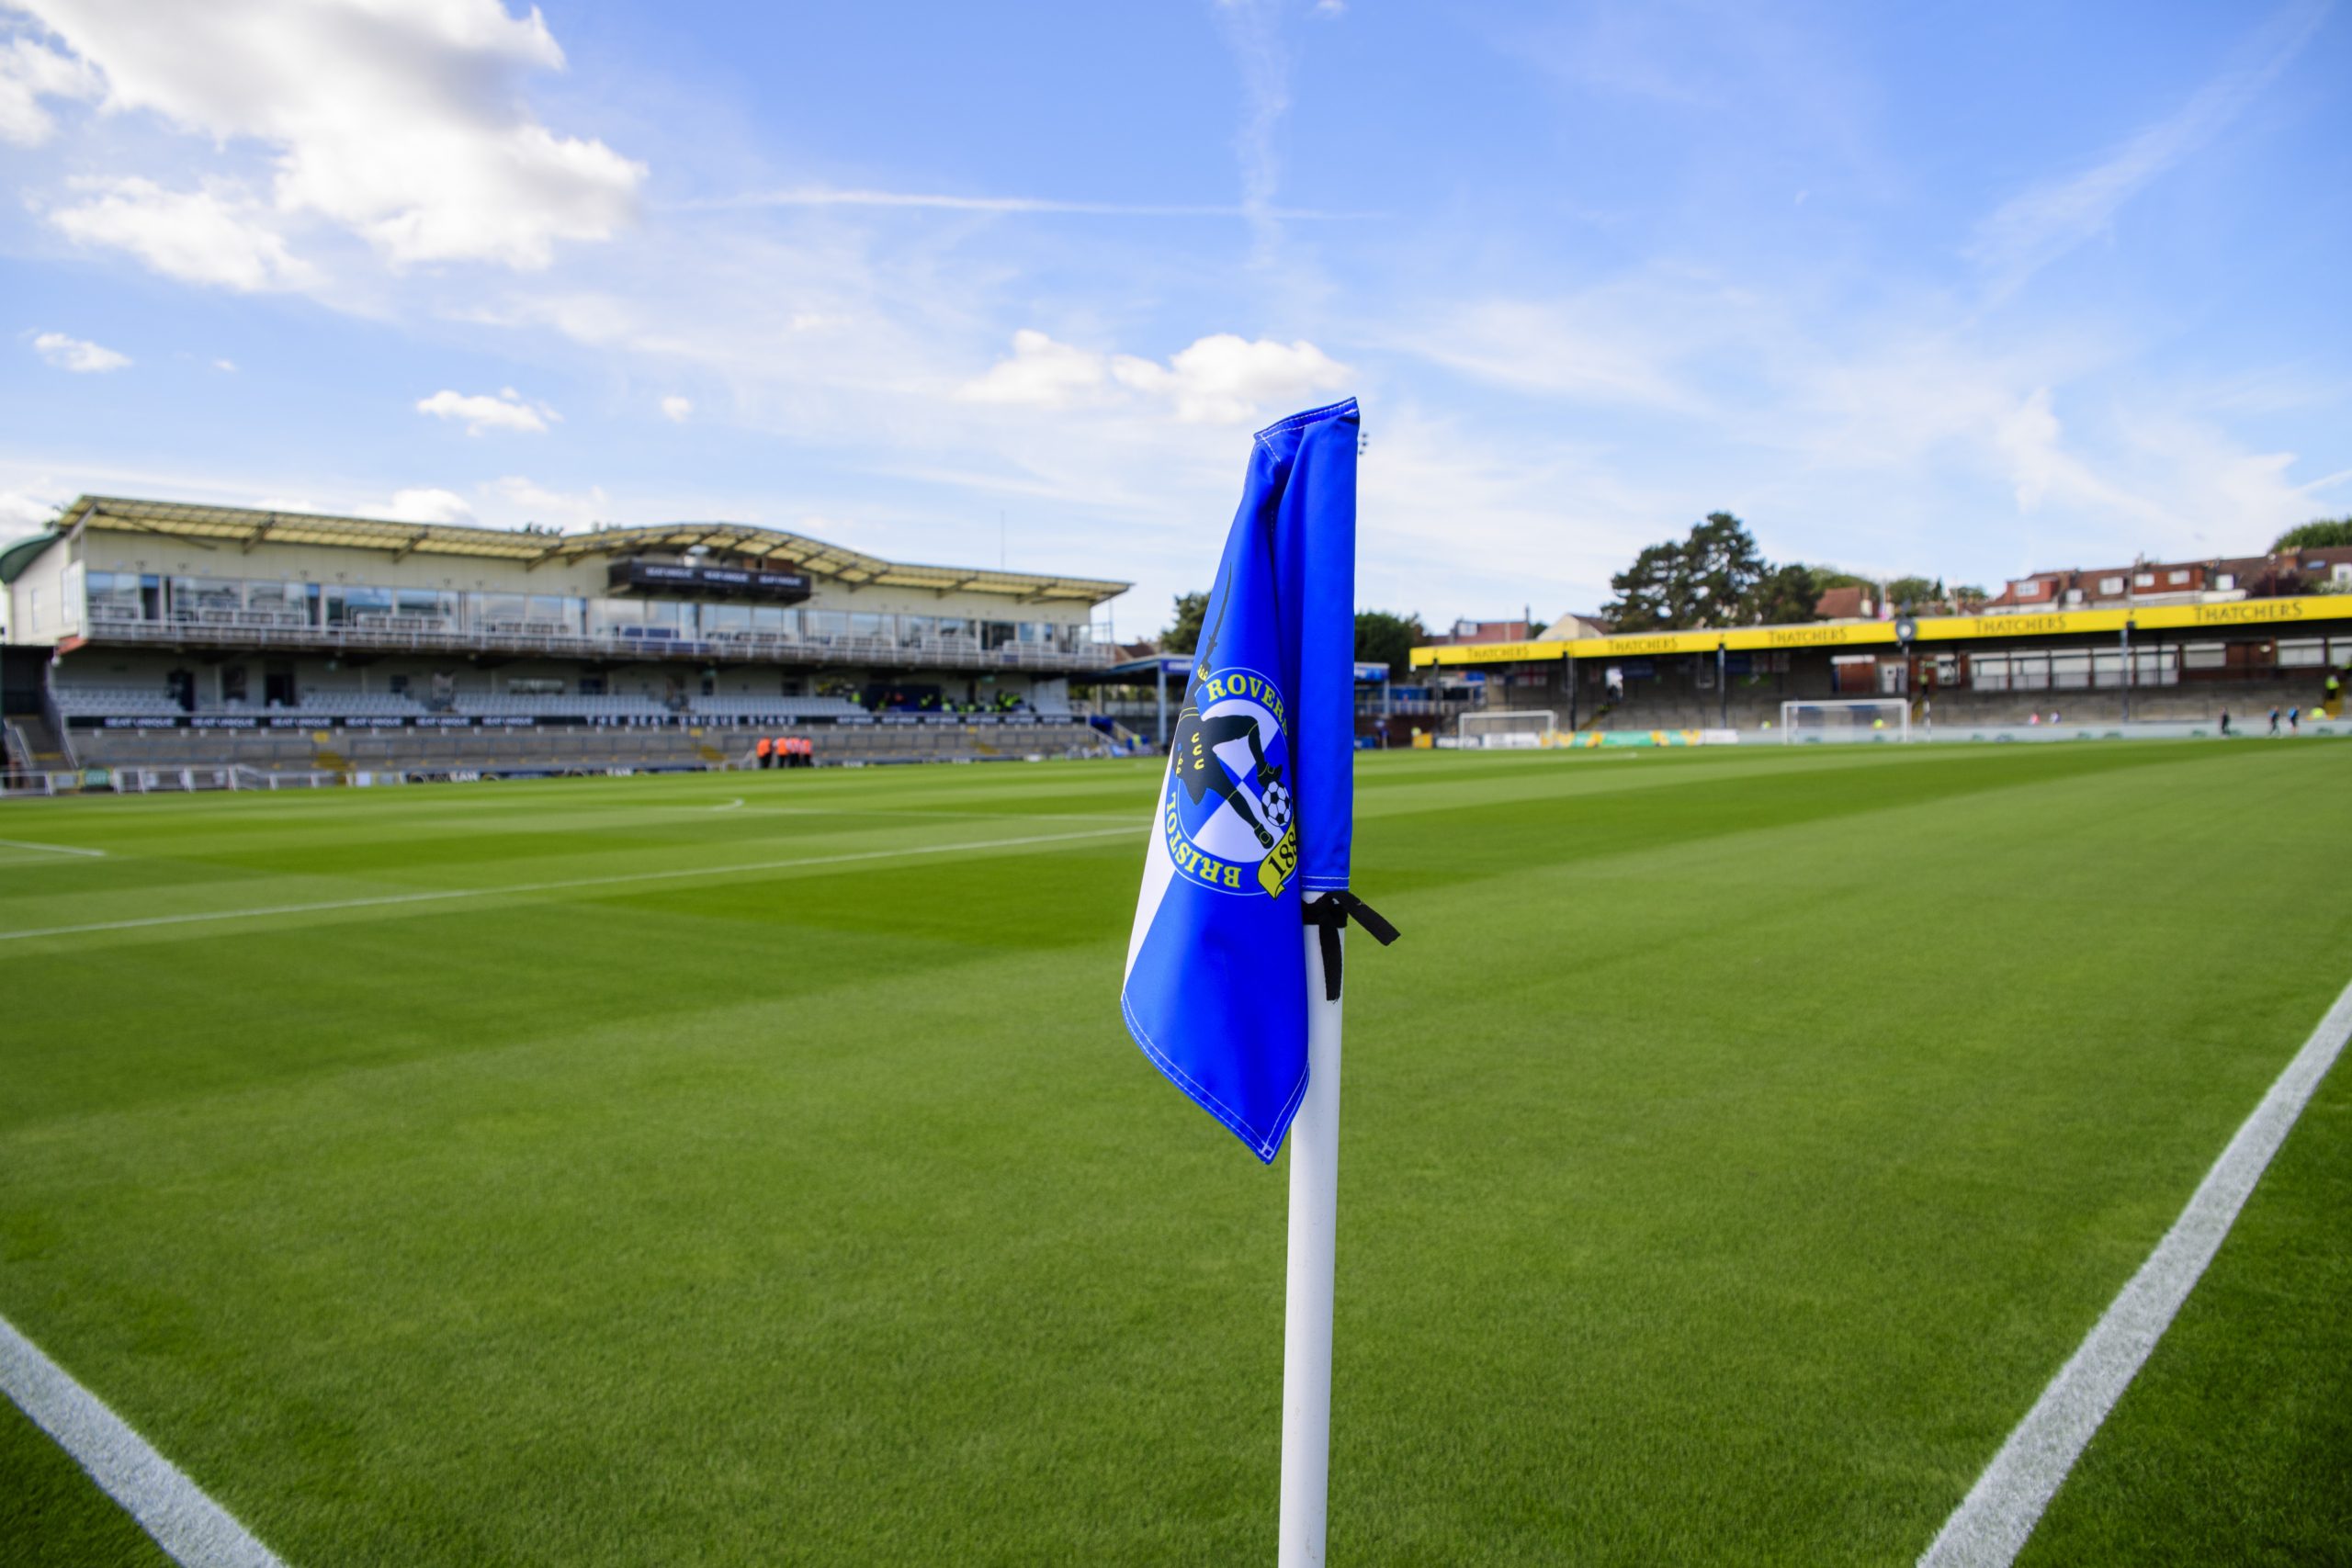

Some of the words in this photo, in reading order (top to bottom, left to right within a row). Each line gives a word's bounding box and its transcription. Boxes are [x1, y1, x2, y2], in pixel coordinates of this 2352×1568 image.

[2193, 601, 2303, 623] THATCHERS
[1973, 615, 2067, 635] THATCHERS
[1608, 637, 1679, 651] THATCHERS
[1768, 628, 1848, 643] THATCHERS
[1466, 647, 1529, 660] THATCHERS
[1166, 791, 1241, 888] BRISTOL
